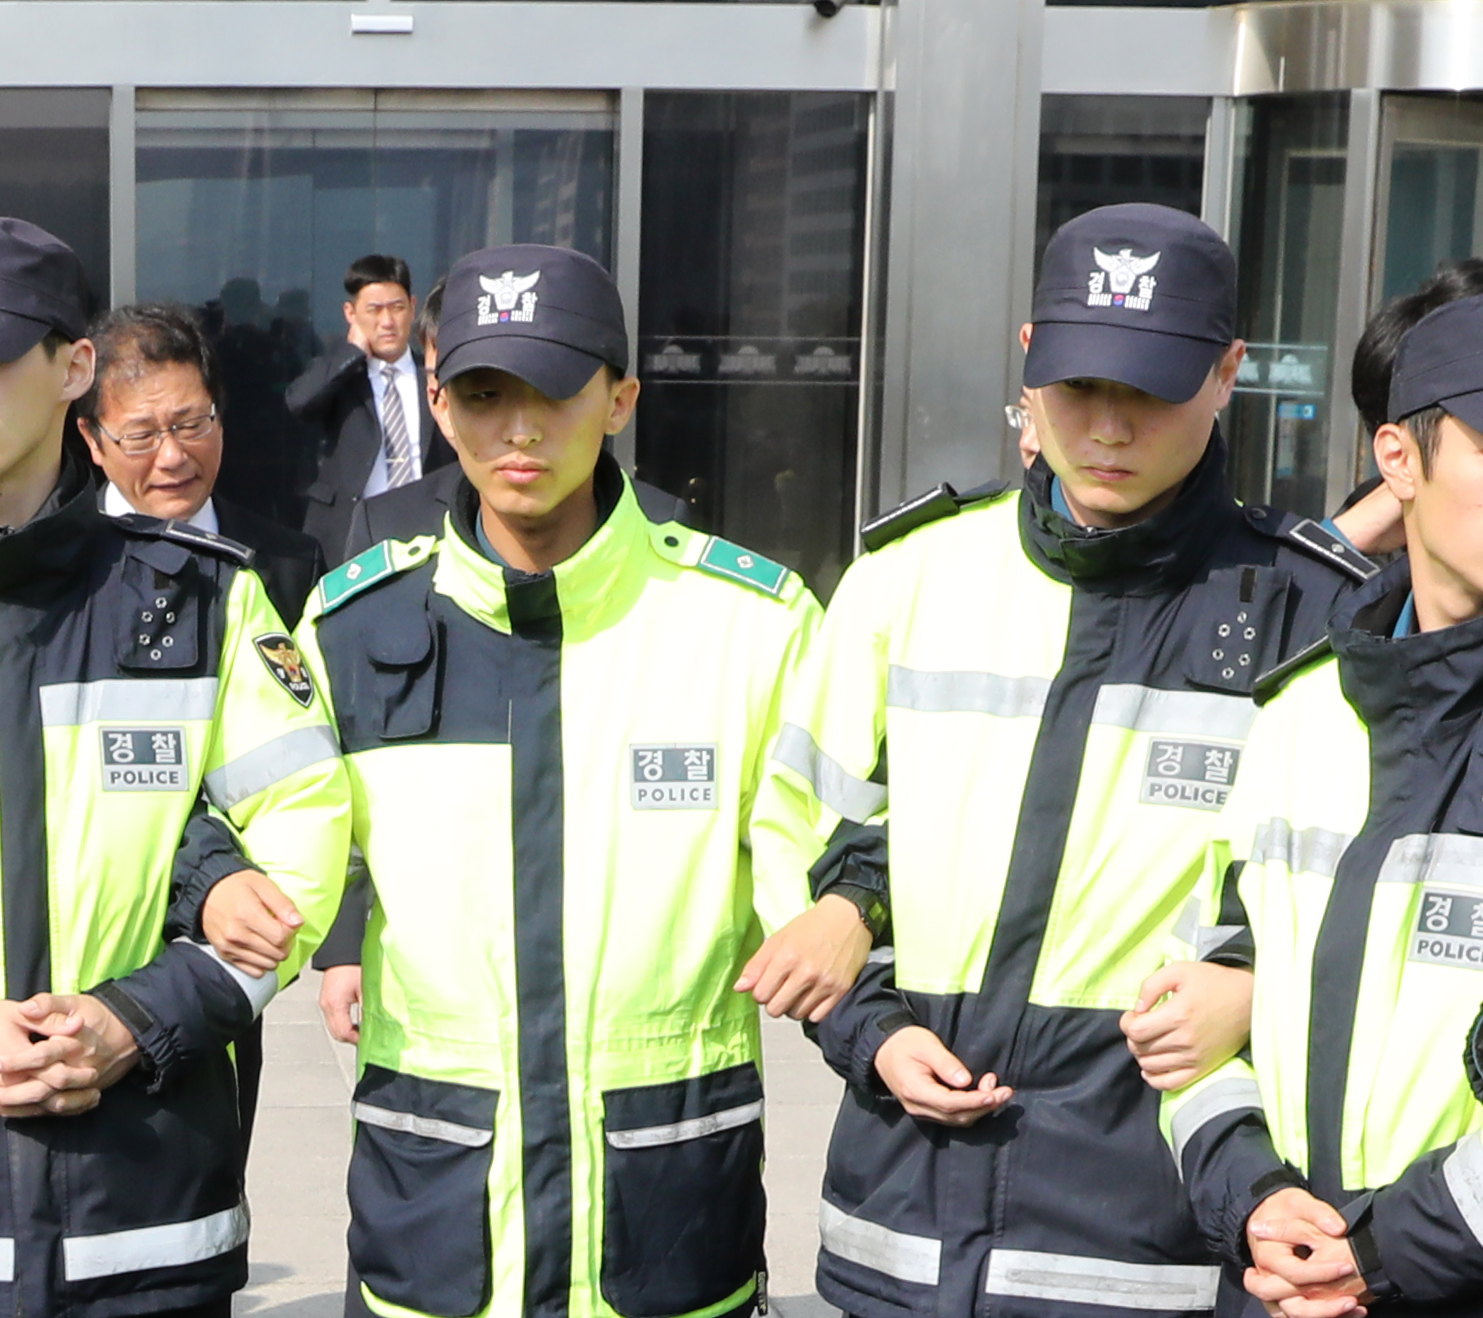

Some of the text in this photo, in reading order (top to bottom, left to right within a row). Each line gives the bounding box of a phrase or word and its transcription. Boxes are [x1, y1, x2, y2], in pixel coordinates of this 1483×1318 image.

[110, 770, 179, 784] POLICE
[638, 787, 711, 802] POLICE
[1149, 783, 1229, 805] POLICE
